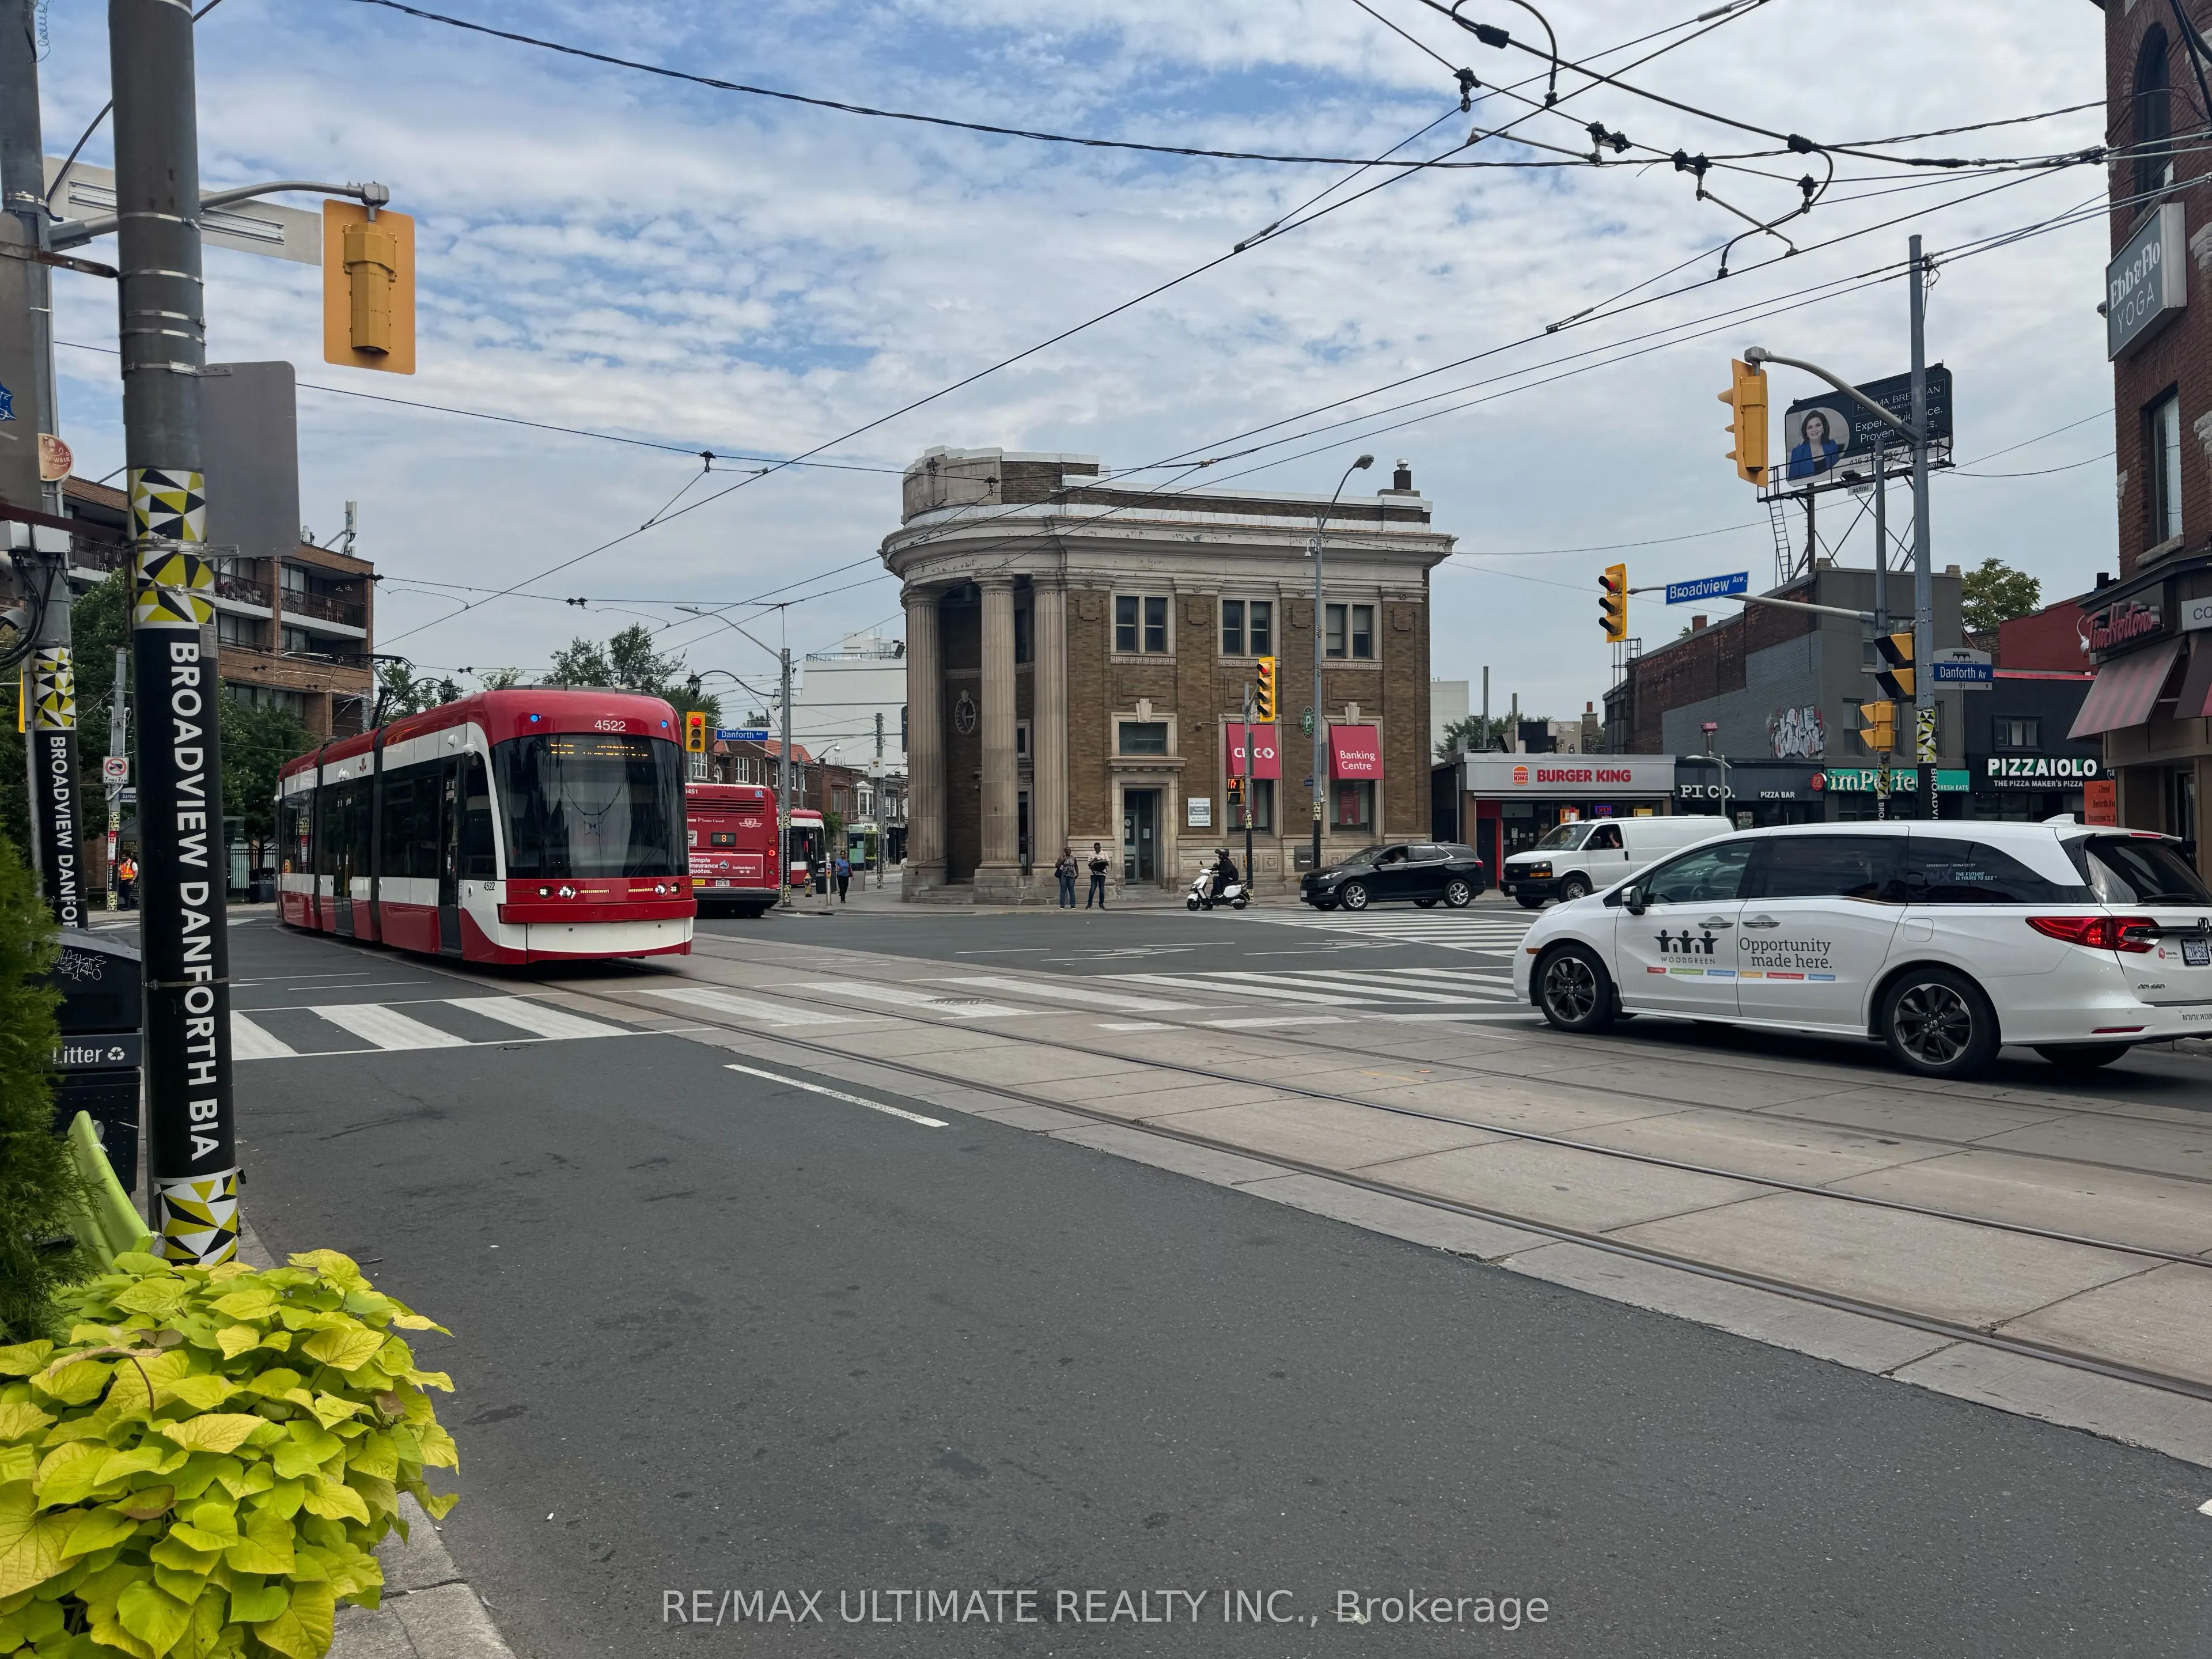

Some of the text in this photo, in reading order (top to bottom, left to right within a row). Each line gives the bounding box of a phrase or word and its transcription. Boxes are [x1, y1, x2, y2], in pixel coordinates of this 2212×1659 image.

[2118, 282, 2154, 334] YOGA
[1893, 385, 1940, 403] BREAN
[1861, 429, 1895, 443] Proven
[1852, 485, 1869, 493] astral
[1670, 575, 1747, 599] Broadview Ave.
[1940, 666, 1986, 679] Danforth Av
[594, 720, 626, 732] 4522
[721, 730, 754, 738] Danforth
[1234, 747, 1262, 758] CIC
[1340, 751, 1376, 762] Banking
[1342, 761, 1372, 770] Centre
[1988, 759, 2097, 777] PIZZAIOLO
[1537, 770, 1631, 782] BURGER KING
[1830, 770, 1918, 791] imPrfe
[2031, 779, 2062, 787] MAKER'S
[50, 737, 73, 849] BROADVIEW
[1680, 785, 1736, 798] PI CO.
[721, 834, 726, 842] 8
[483, 881, 495, 891] 4522
[170, 642, 219, 1161] BROADVIEW DANFORTH BIA
[1740, 937, 1831, 956] Opportunity
[1660, 956, 1716, 964] WOODGREEN
[1751, 953, 1832, 968] made here.
[53, 1046, 103, 1065] Litter
